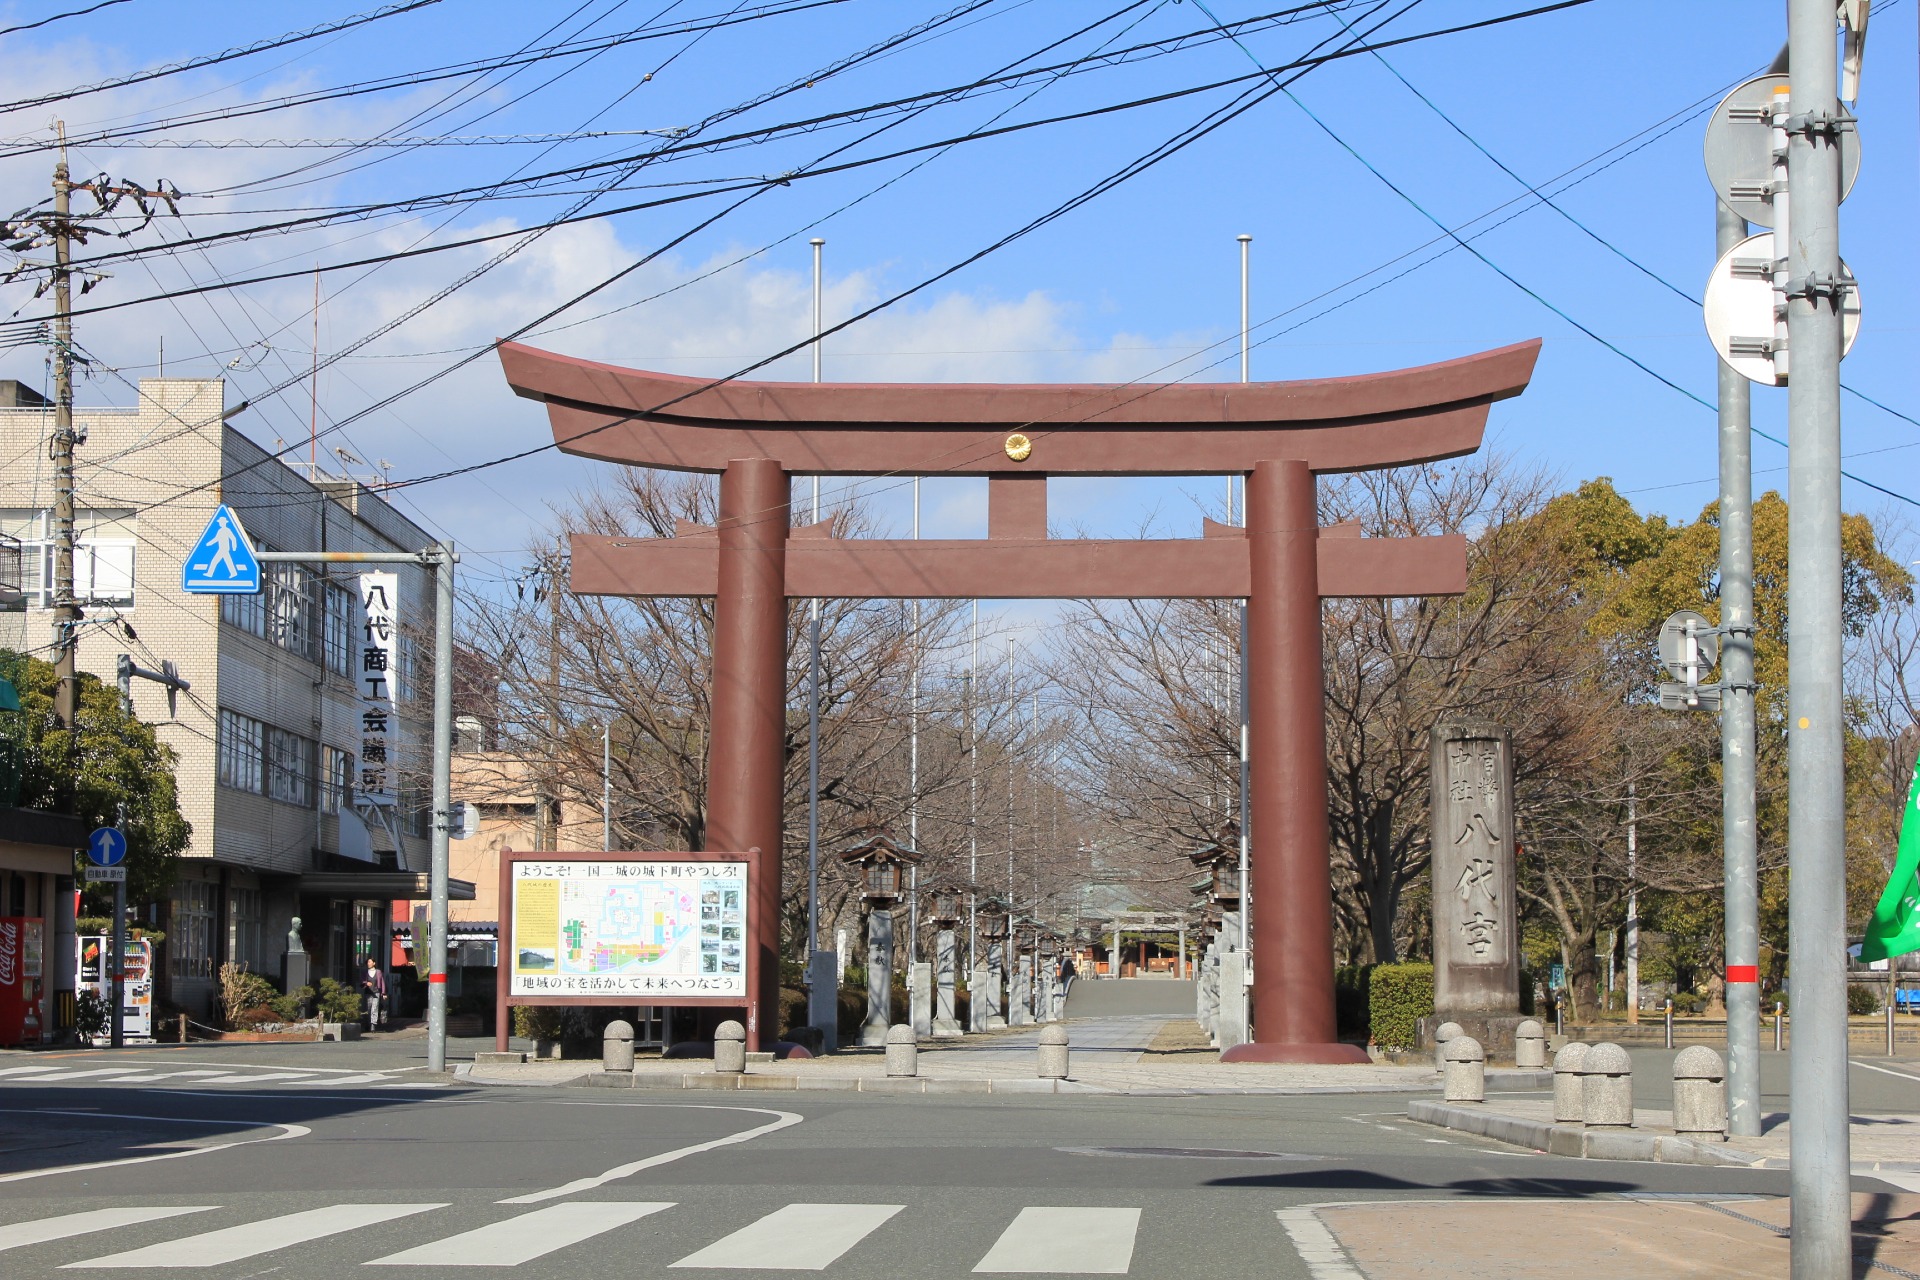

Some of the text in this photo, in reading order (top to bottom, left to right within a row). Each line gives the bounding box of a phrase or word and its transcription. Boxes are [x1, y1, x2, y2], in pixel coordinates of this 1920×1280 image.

[363, 585, 389, 794] 八代商工会議所
[88, 870, 124, 879] 自動車 原付
[1453, 813, 1500, 958] 八代宮
[515, 977, 740, 990] 「地域の宝を活かして未来へつなごう」
